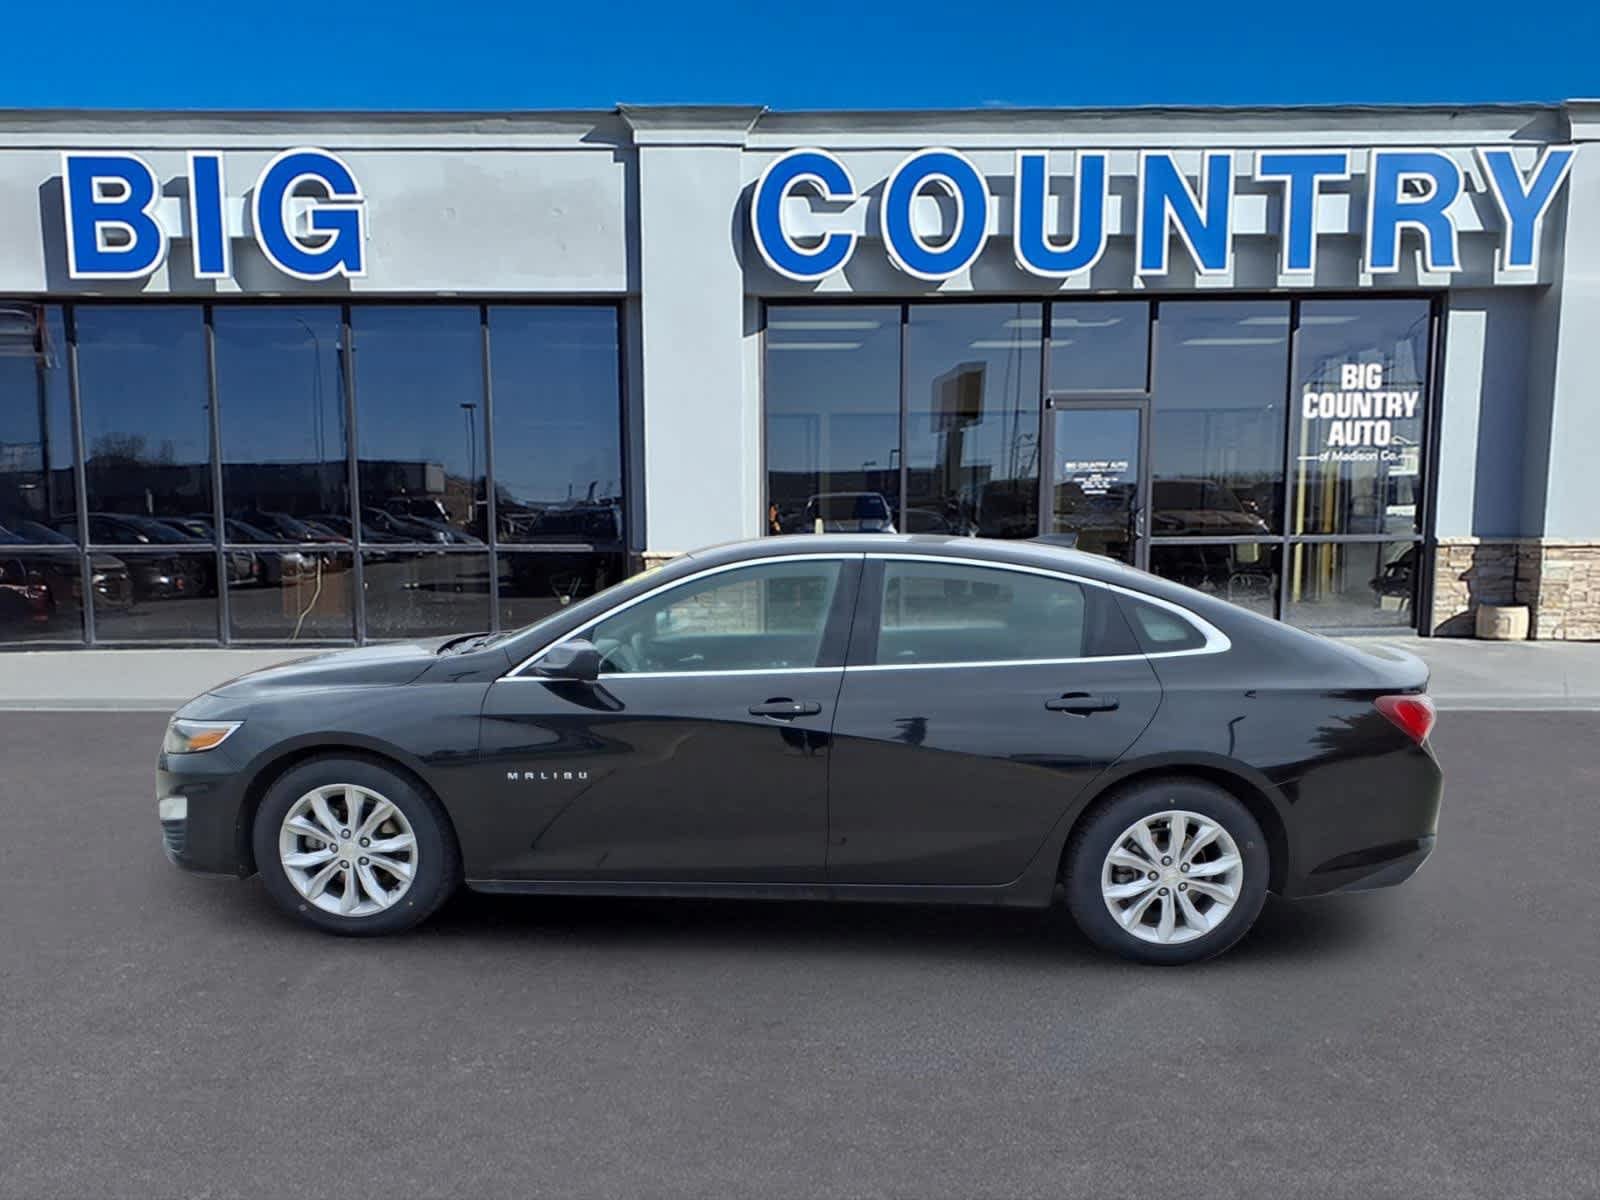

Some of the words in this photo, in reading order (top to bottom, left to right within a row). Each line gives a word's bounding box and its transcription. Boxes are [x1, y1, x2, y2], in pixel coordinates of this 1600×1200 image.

[61, 147, 367, 280] BIG
[753, 146, 1577, 281] COUNTRY
[1341, 364, 1382, 390] BIG
[1303, 392, 1419, 418] COUNTRY
[1328, 421, 1391, 446] AUTO
[1319, 451, 1329, 461] of
[1331, 451, 1378, 461] Madison
[507, 772, 588, 780] MALIBU
